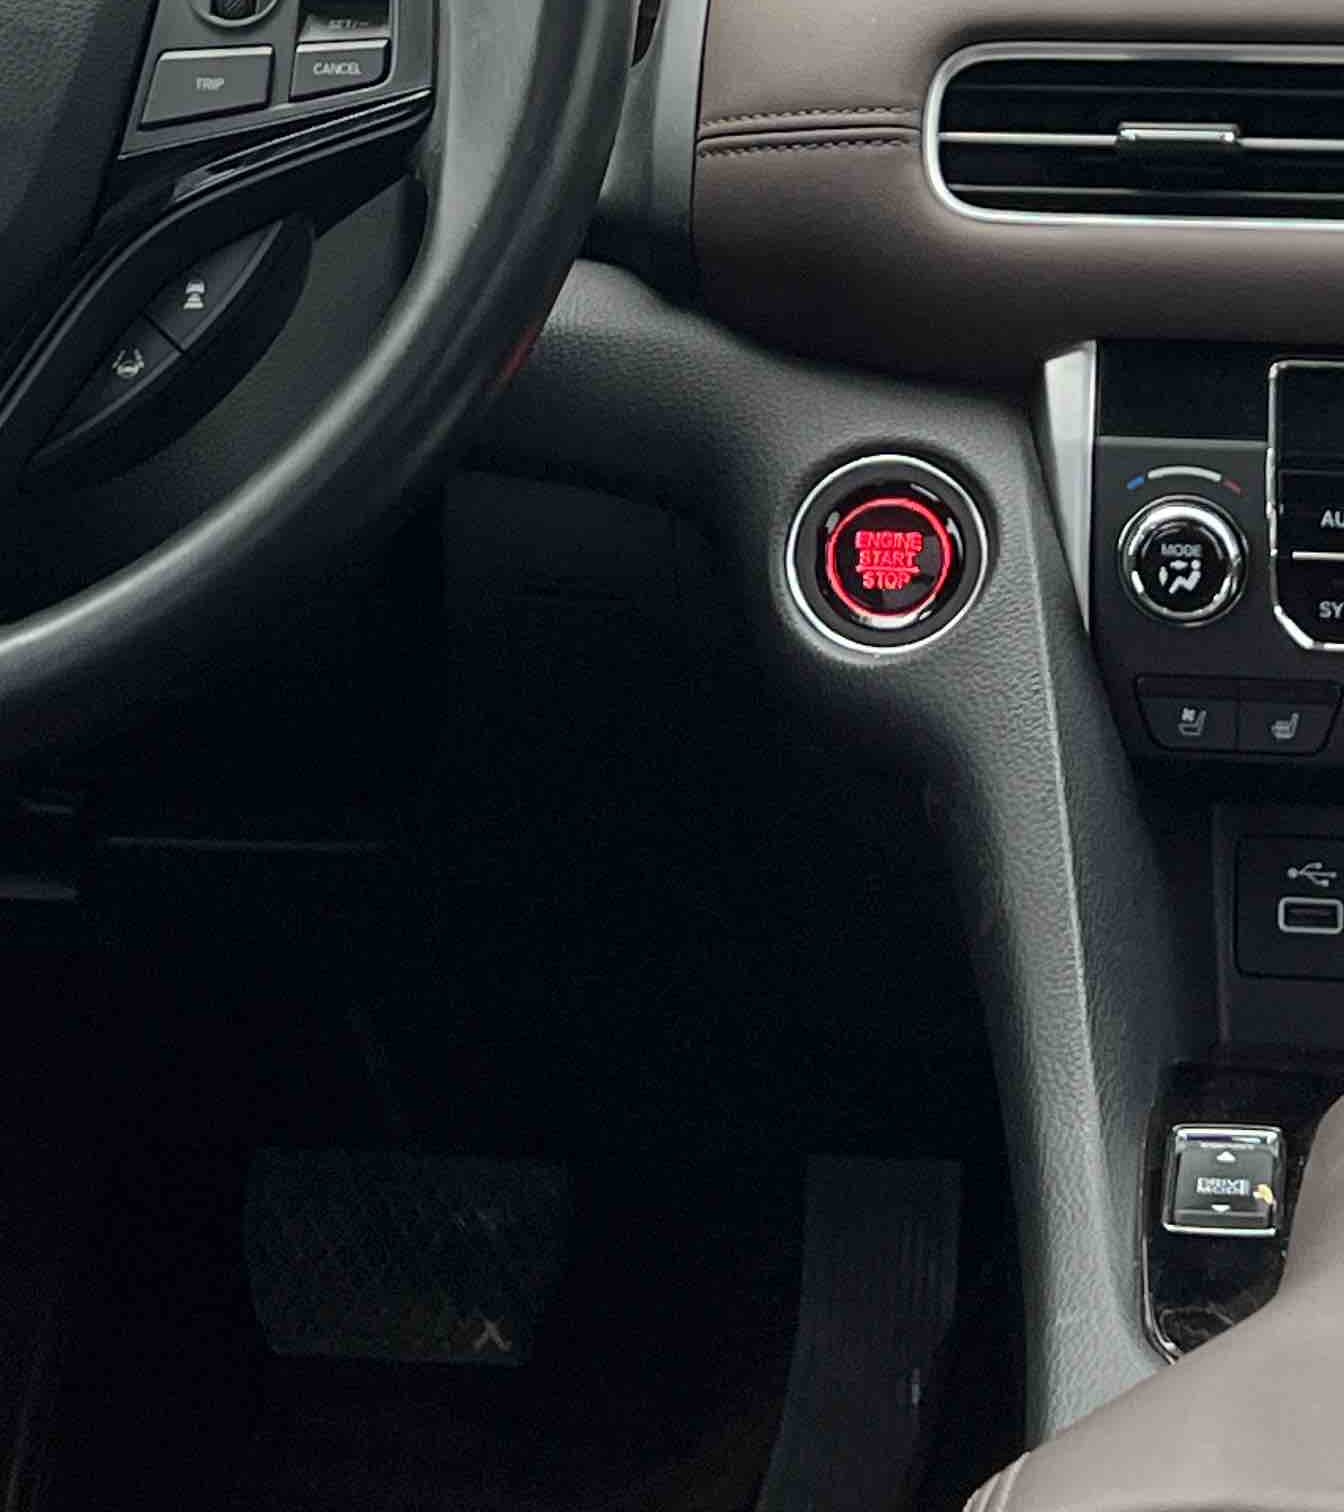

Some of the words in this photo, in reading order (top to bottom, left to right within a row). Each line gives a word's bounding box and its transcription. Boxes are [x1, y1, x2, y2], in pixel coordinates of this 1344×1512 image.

[312, 62, 362, 76] CANCEL
[195, 77, 225, 91] TRIP
[855, 531, 923, 552] ENGINE
[1160, 543, 1202, 558] MODE
[859, 550, 916, 568] START
[862, 571, 912, 590] STOP
